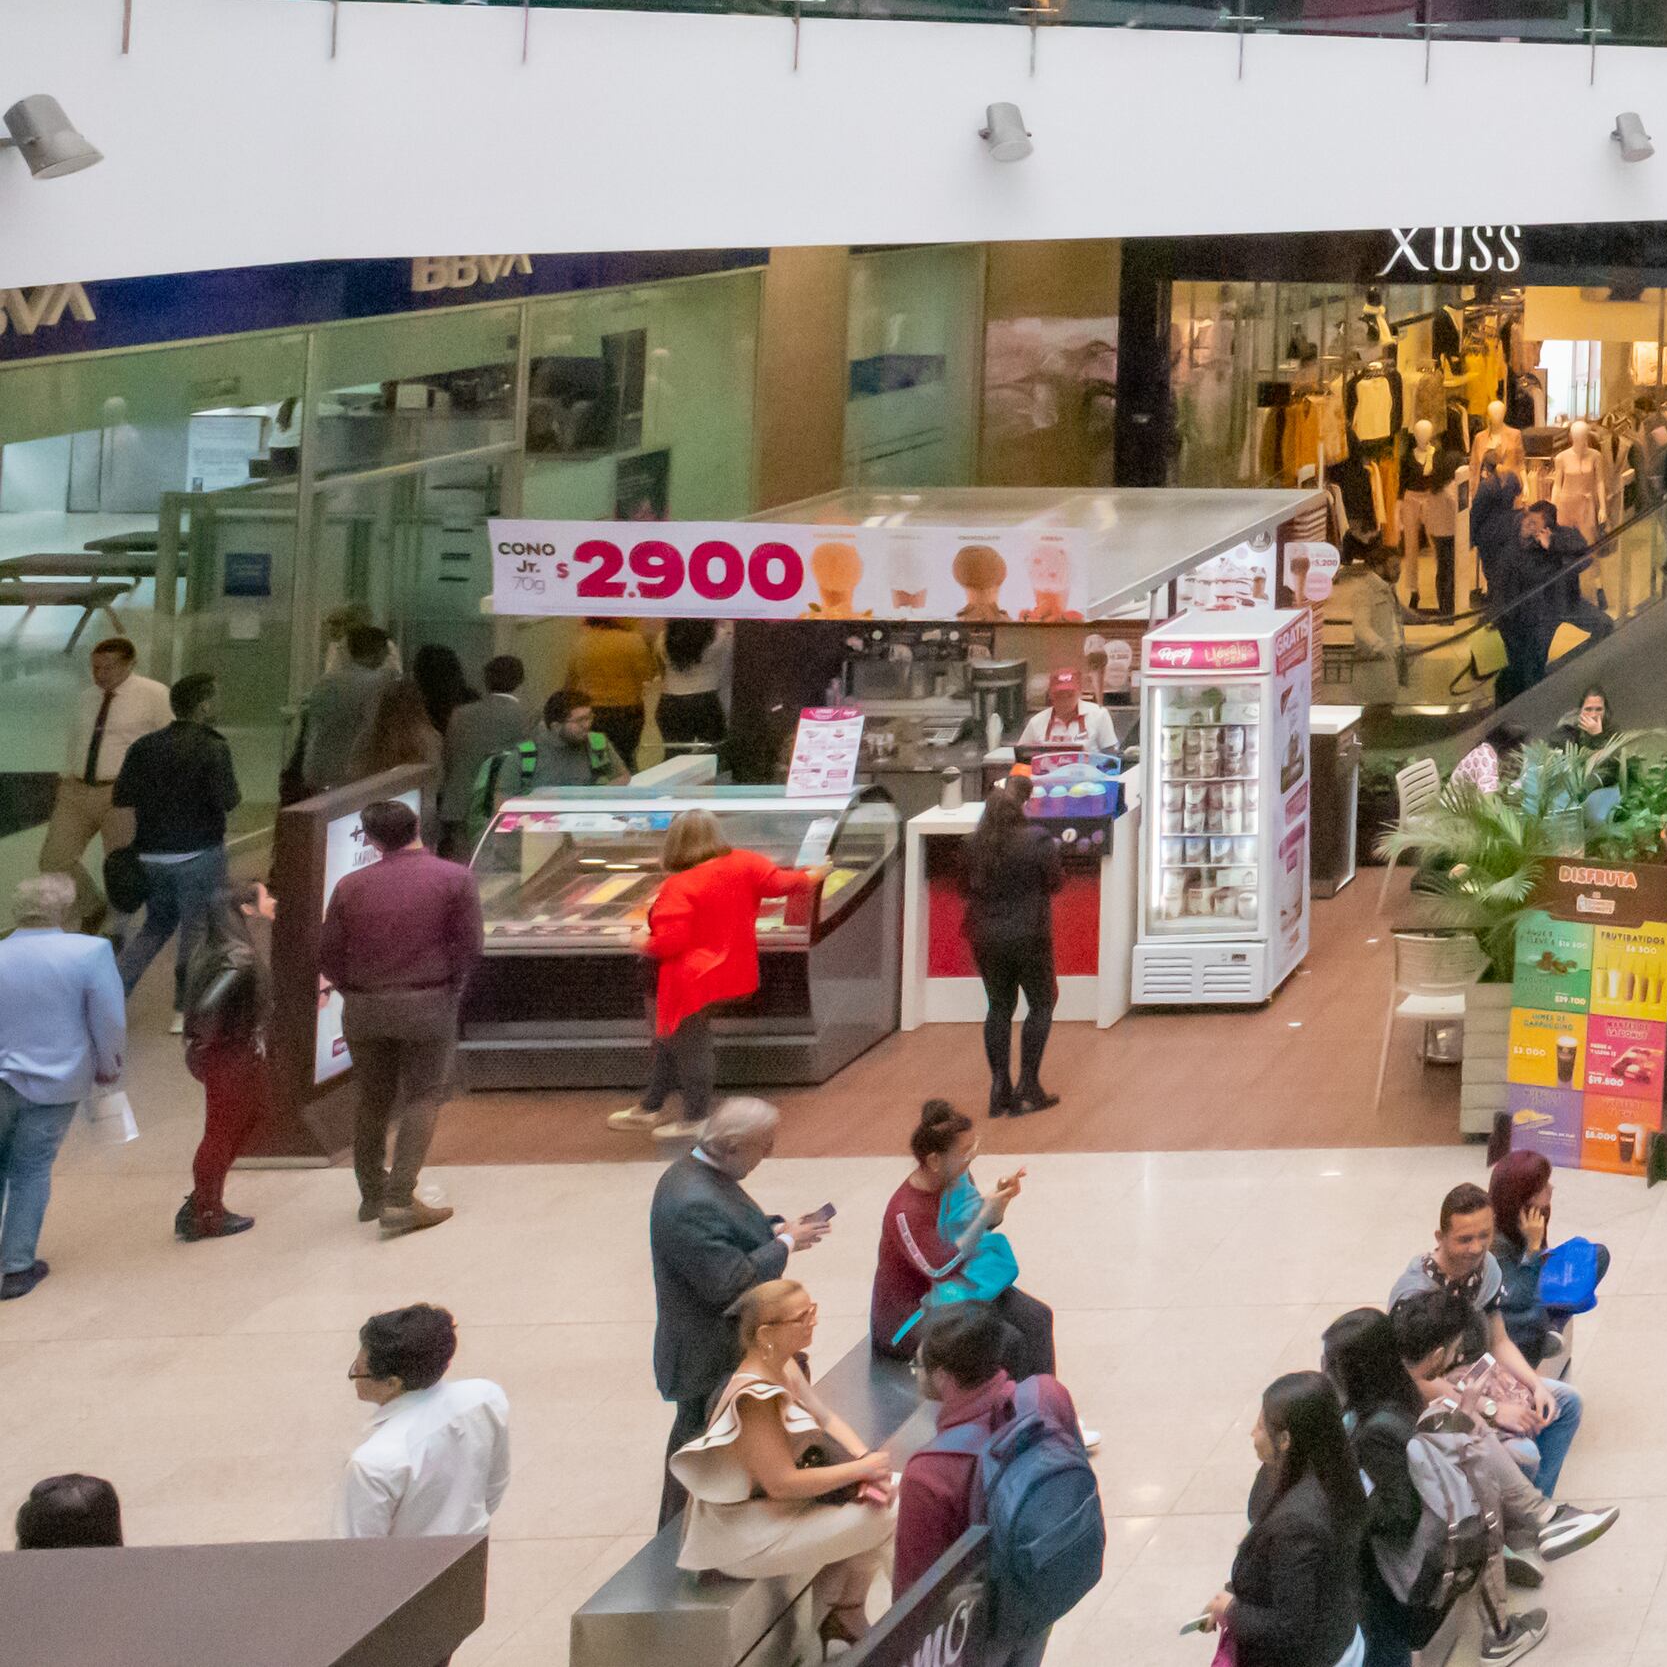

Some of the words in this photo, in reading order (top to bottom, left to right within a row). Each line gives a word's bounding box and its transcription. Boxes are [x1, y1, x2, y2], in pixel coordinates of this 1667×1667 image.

[1374, 225, 1522, 277] XUSS
[497, 541, 556, 557] CONO
[555, 562, 569, 580] $
[573, 539, 805, 602] 2.900
[512, 576, 546, 595] 70g
[1558, 864, 1638, 890] DISFRUTA
